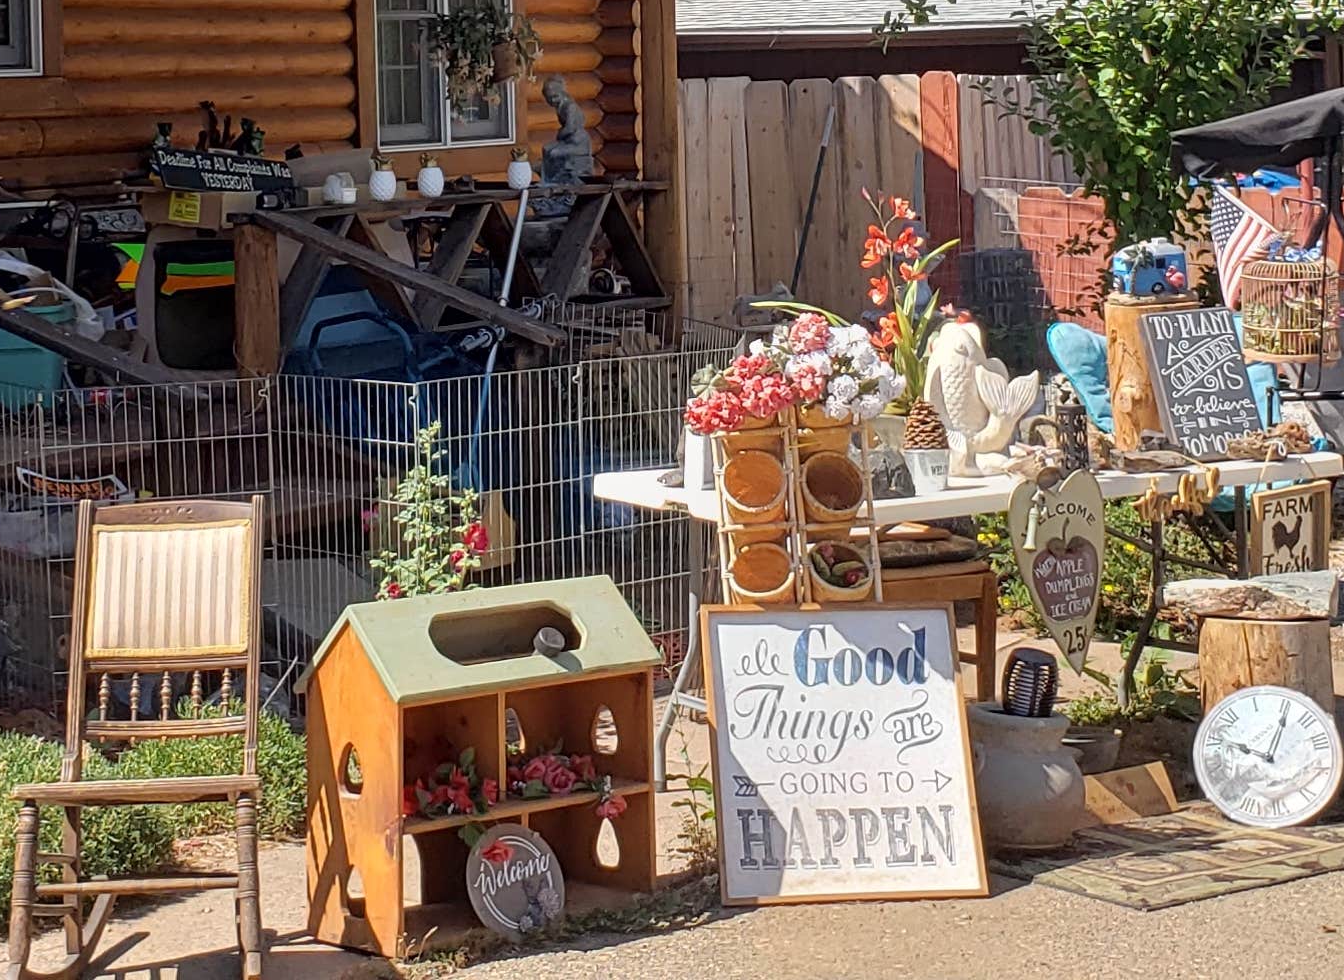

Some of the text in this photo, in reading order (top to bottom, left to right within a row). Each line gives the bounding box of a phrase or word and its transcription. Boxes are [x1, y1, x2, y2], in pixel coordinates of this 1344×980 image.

[158, 151, 292, 178] Deadline For All Complaints Was
[201, 172, 254, 191] YESTERDAY
[1171, 340, 1236, 388] GARDEN
[1217, 361, 1244, 389] IS
[1170, 395, 1255, 416] to believe
[1197, 415, 1231, 429] IN
[1262, 495, 1313, 521] FARM
[1056, 559, 1084, 577] APPLE
[1262, 543, 1312, 575] Fresh
[1045, 573, 1095, 595] DUMPLINGS
[1050, 603, 1067, 618] ICE
[793, 624, 929, 687] Good
[730, 683, 873, 764] Things
[779, 772, 914, 795] GOING TO
[737, 804, 956, 870] HAPPEN
[473, 853, 550, 896] Welcome
